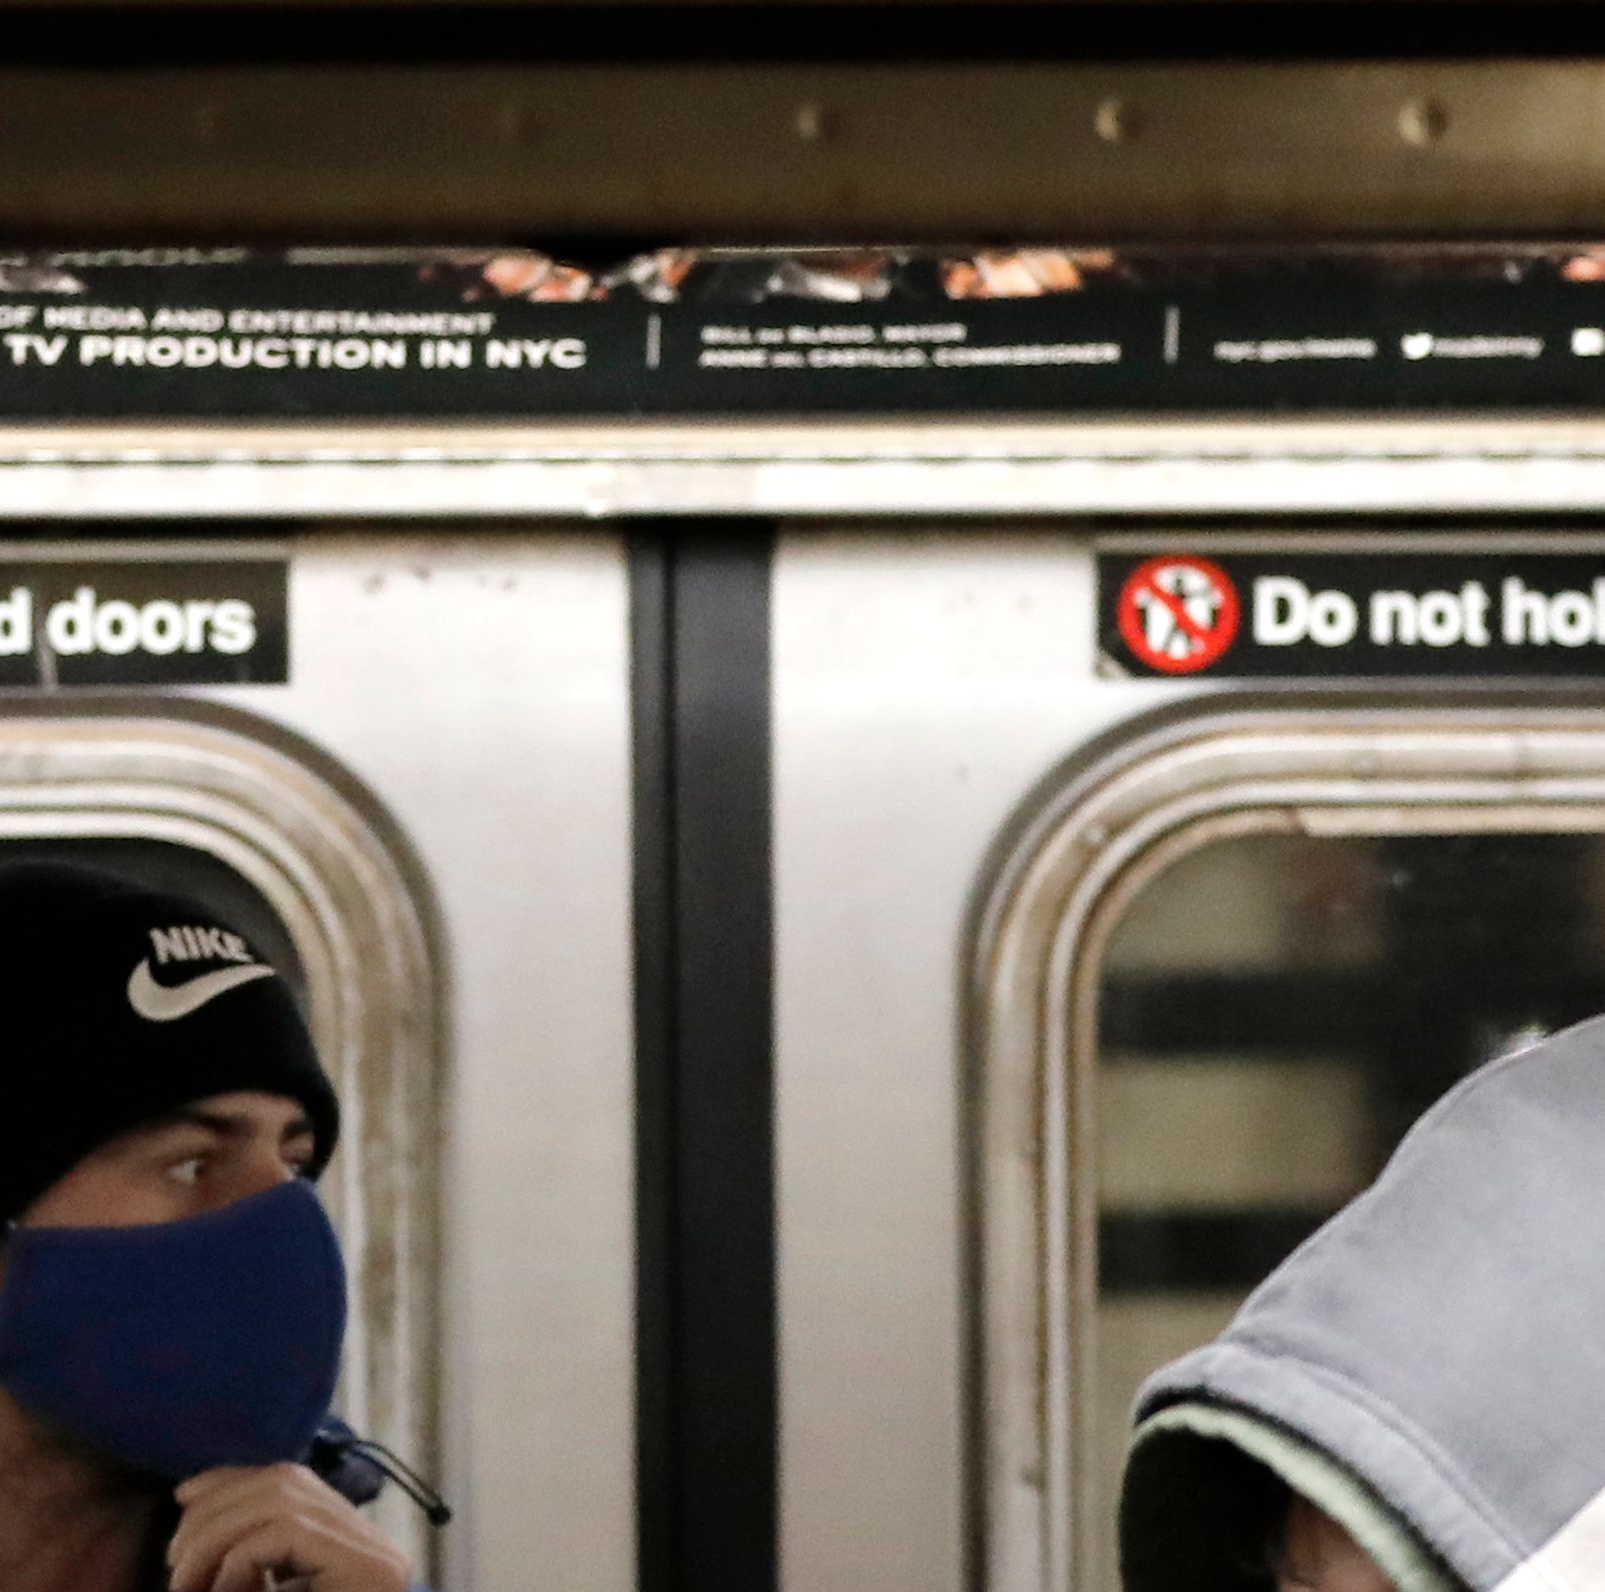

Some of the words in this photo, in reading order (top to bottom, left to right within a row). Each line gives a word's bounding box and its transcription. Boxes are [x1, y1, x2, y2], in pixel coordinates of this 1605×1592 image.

[43, 305, 147, 331] MEDIA
[150, 307, 225, 333] AND
[228, 309, 496, 335] ENTERTAINMENT
[3, 334, 69, 366] TV
[79, 334, 408, 369] PRODUCTION
[418, 338, 473, 369] IN
[484, 337, 587, 369] NYC
[45, 586, 257, 657] doors
[1252, 576, 1358, 647] Do
[1369, 581, 1489, 647] not
[149, 925, 254, 964] NIKE
